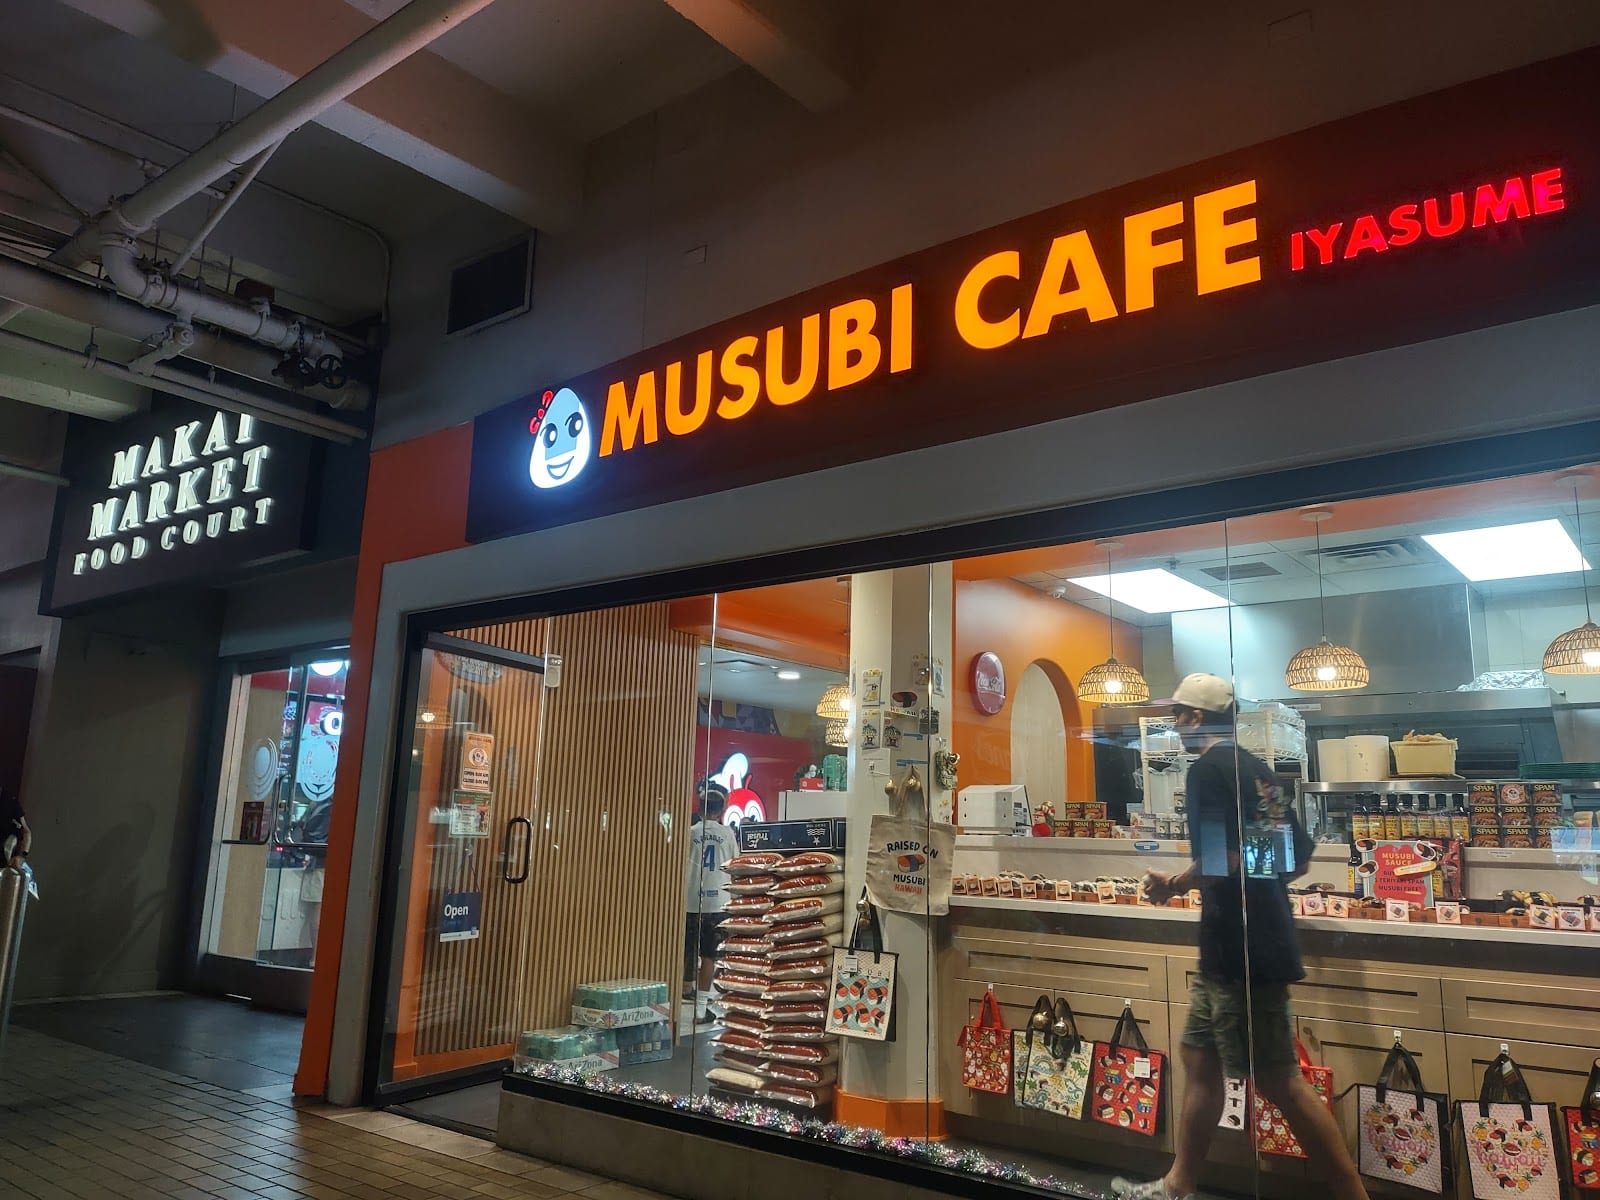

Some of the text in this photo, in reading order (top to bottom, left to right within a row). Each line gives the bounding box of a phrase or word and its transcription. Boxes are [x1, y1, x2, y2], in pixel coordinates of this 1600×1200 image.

[1291, 168, 1565, 272] IYASUME
[599, 179, 1262, 457] MUSUBI CAFE
[108, 411, 255, 489] MAKAI
[87, 445, 271, 540] MARKET
[73, 497, 273, 575] FOOD COURT
[703, 845, 716, 871] 4
[887, 841, 939, 859] RAISED ON
[1382, 852, 1415, 860] MUSUBI
[893, 874, 926, 886] MUSUBI
[895, 884, 923, 895] HAWAII
[444, 904, 469, 919] Open
[621, 1009, 654, 1024] AriZona
